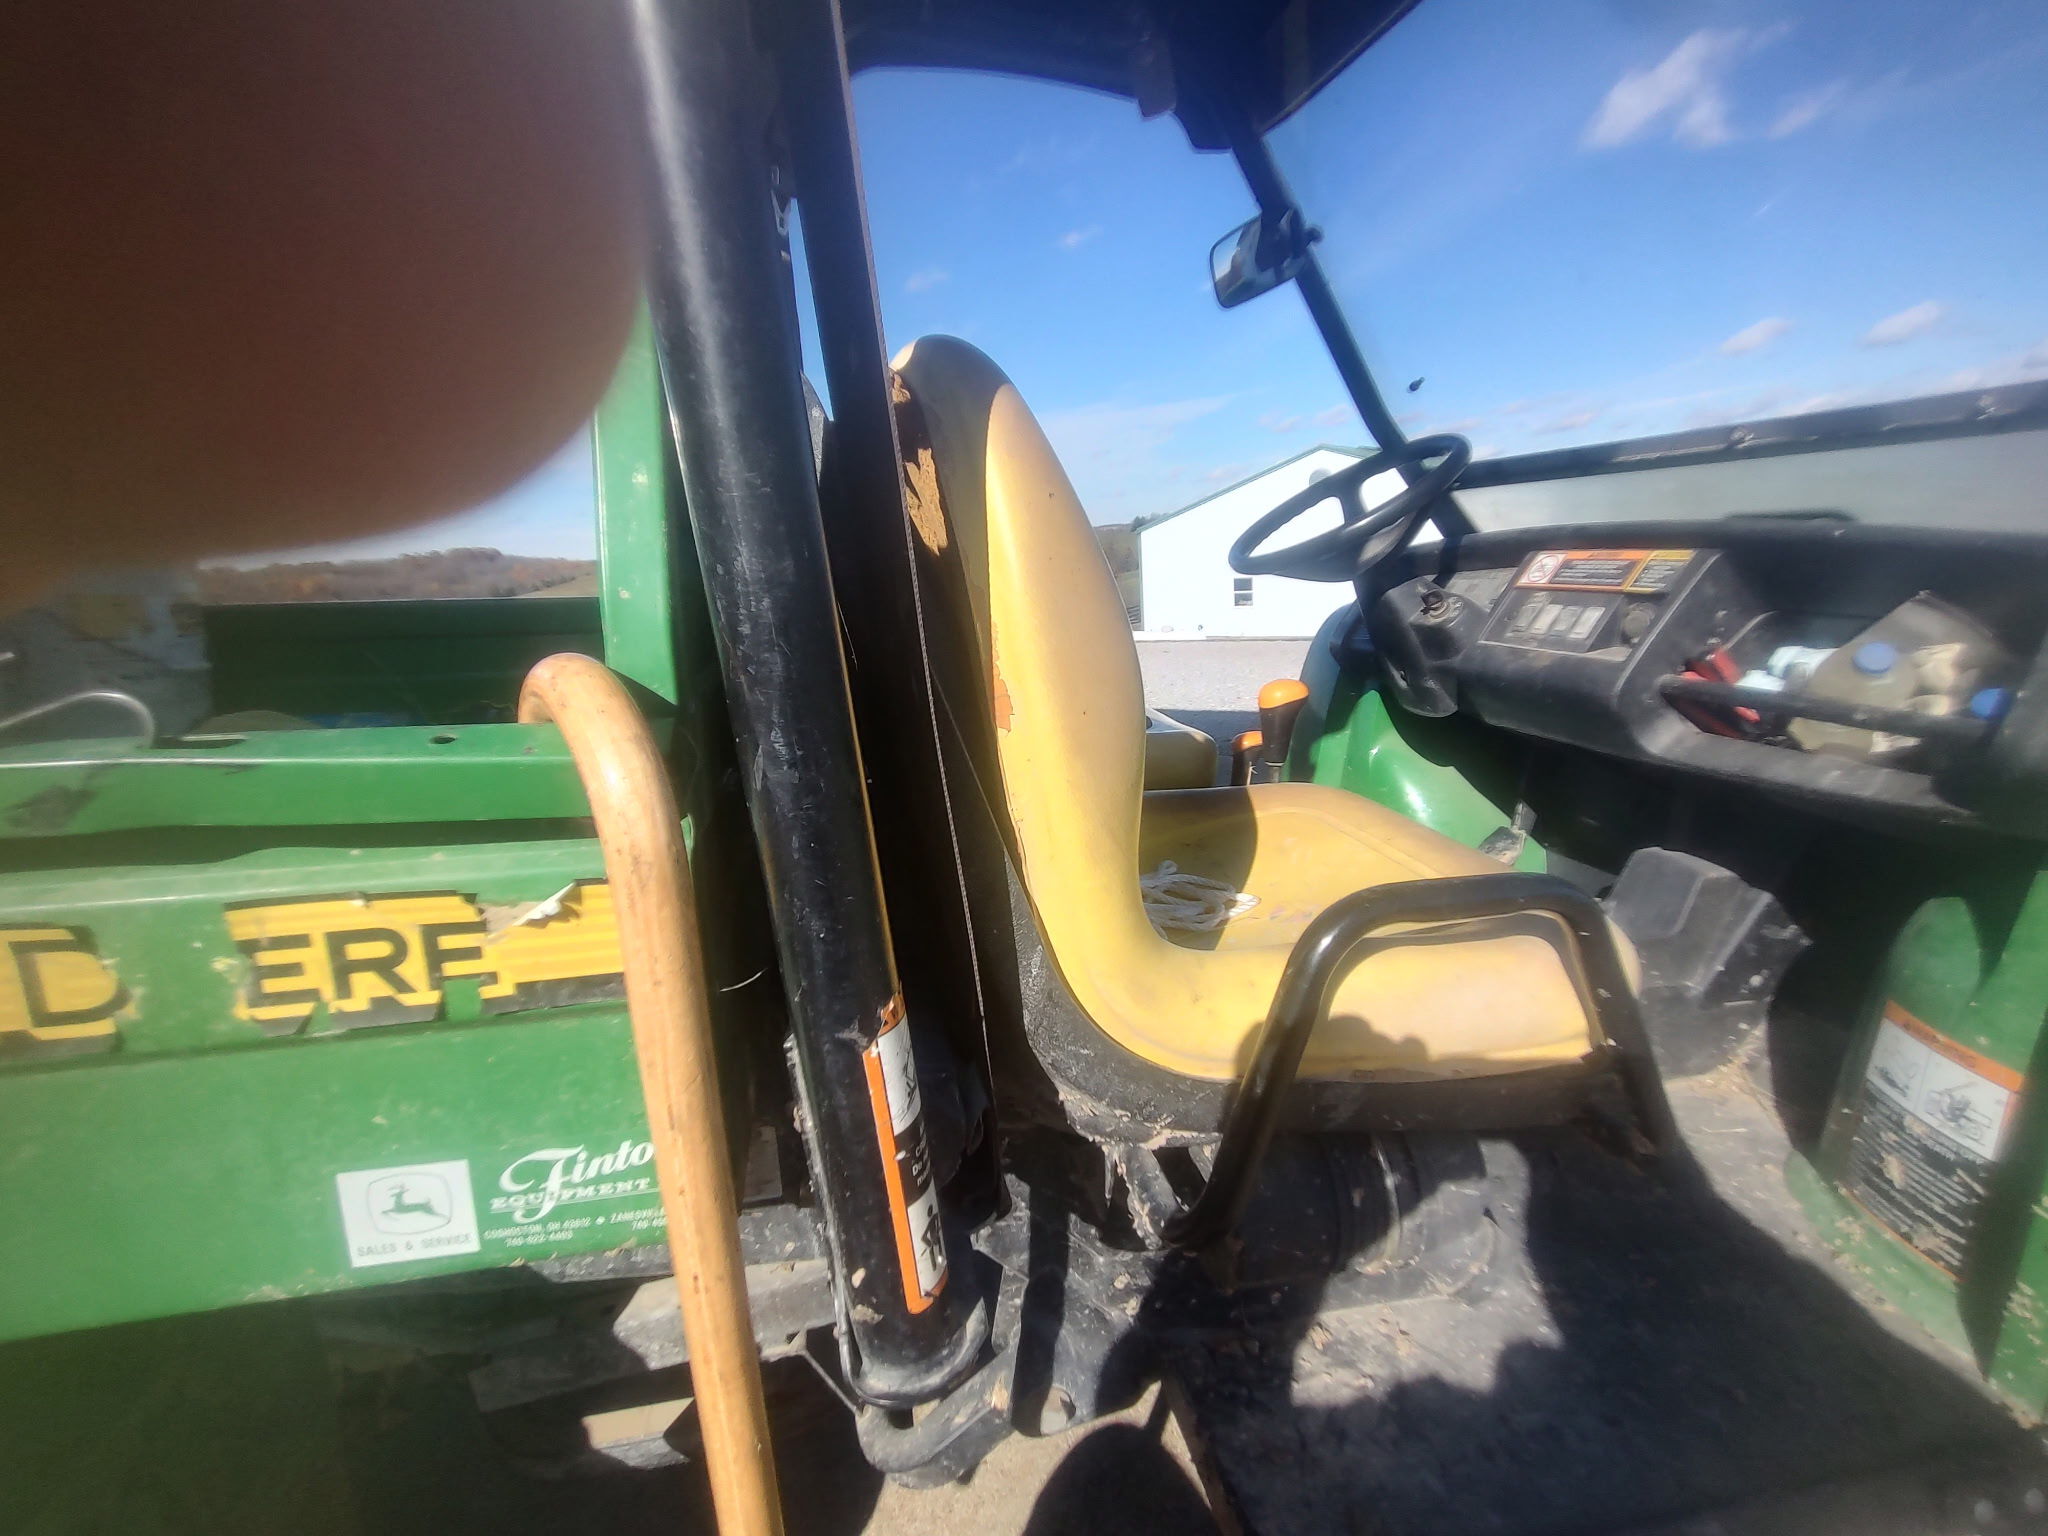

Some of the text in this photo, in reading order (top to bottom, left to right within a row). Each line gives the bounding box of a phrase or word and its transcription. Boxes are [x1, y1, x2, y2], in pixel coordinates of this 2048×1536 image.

[499, 1139, 655, 1225] Finto
[357, 1242, 397, 1257] SALES
[421, 1234, 473, 1249] SERVICE
